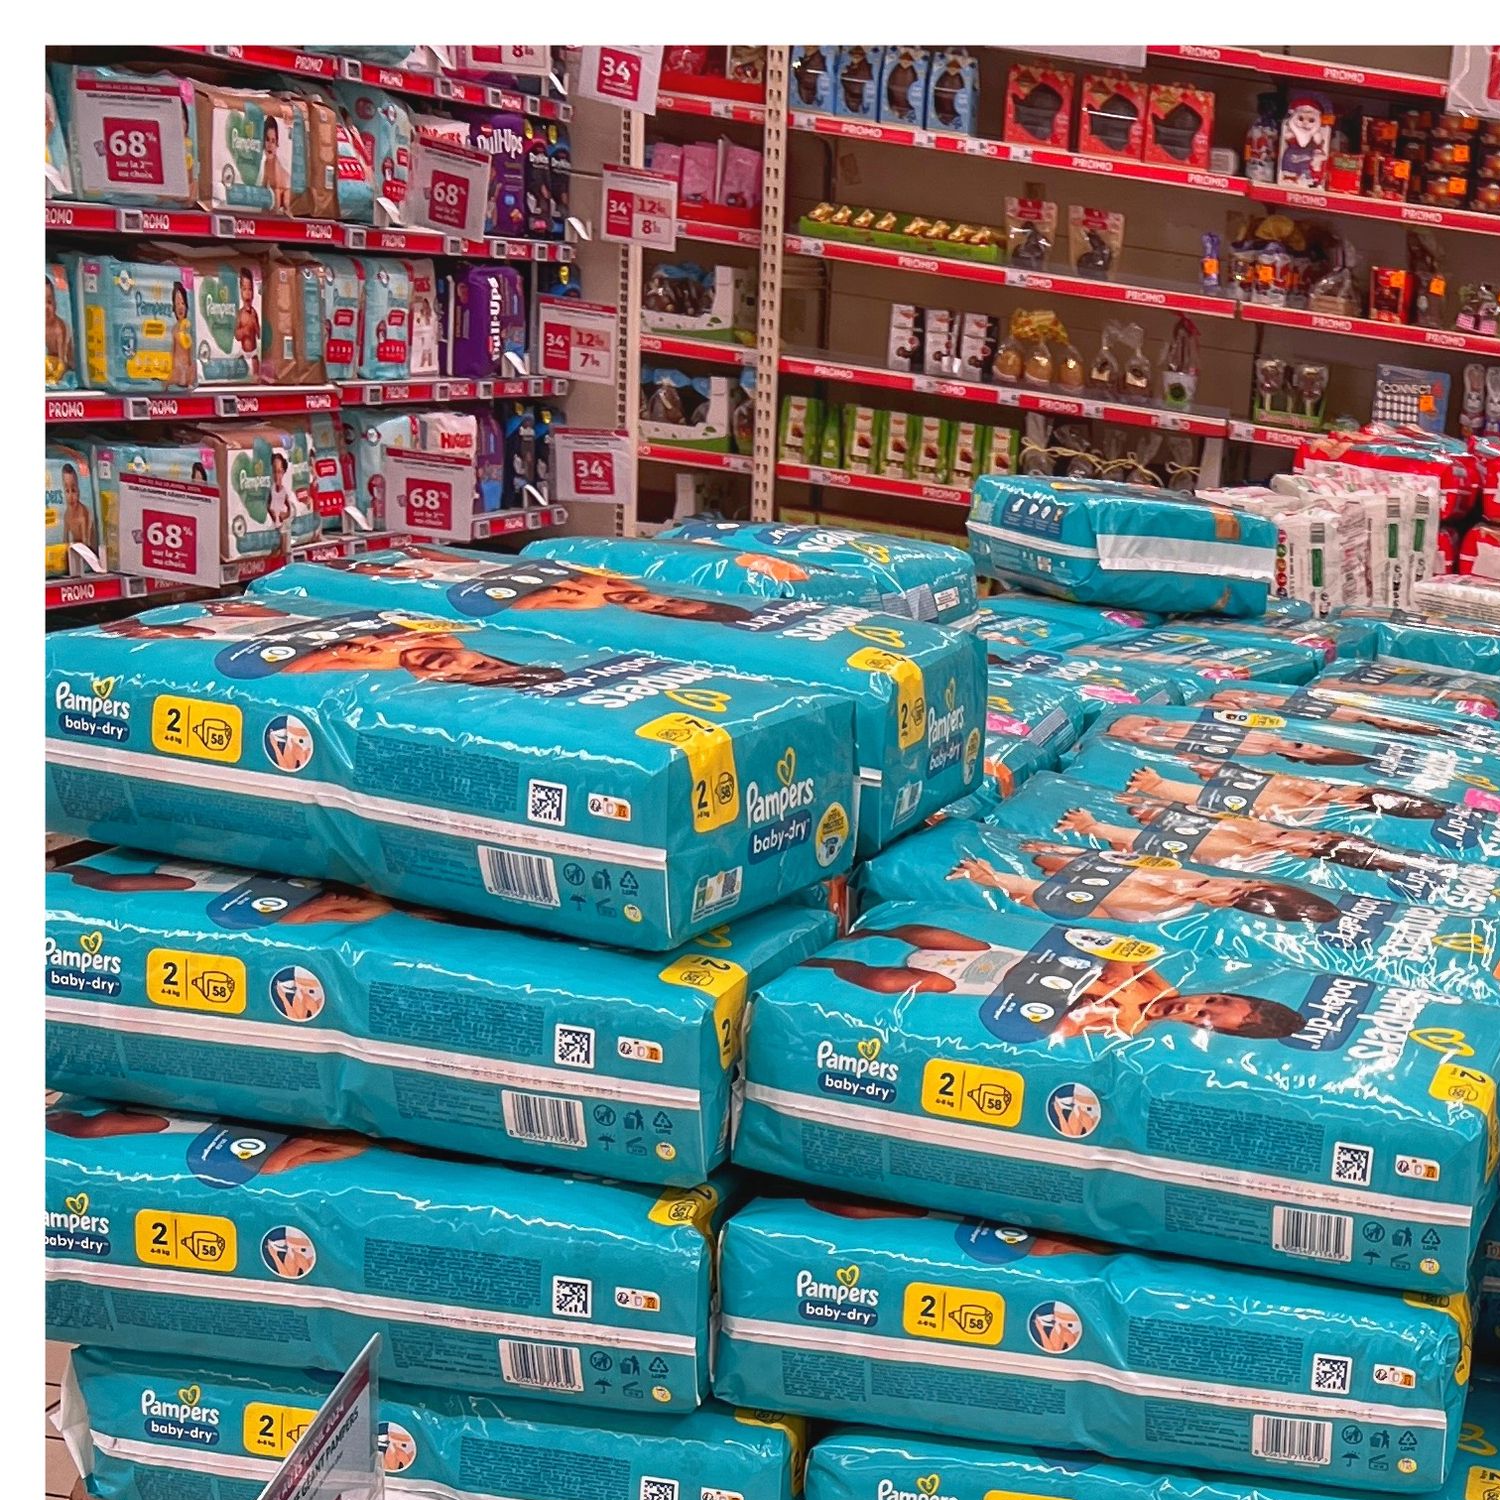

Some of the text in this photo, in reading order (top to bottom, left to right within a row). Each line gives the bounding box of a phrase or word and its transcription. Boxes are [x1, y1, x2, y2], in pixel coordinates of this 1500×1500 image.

[295, 57, 323, 73] PROMO
[1324, 68, 1365, 83] PROMO
[841, 123, 883, 138] PROMO
[898, 257, 939, 271] PROMO
[1312, 316, 1352, 331] PROMO
[49, 402, 84, 417] PROMO
[61, 583, 94, 601] PROMO
[56, 681, 130, 720] Pampers
[65, 716, 124, 740] baby-dry
[167, 708, 224, 746] 2 58
[695, 779, 707, 810] 2
[746, 778, 814, 829] Pampers
[753, 820, 807, 854] baby-dry
[45, 937, 121, 974] Pampers
[51, 972, 116, 996] baby-dry
[163, 962, 227, 998] 2 58
[817, 1048, 900, 1081] Pampers
[824, 1073, 890, 1099] baby-dry
[940, 1072, 1003, 1111] 2 58
[796, 1269, 879, 1306] Pampers
[806, 1303, 872, 1325] baby-dry
[920, 1295, 984, 1330] 2 58
[141, 1389, 220, 1426] Pampers
[151, 1422, 212, 1441] baby-dry
[259, 1415, 274, 1438] 2
[325, 1406, 359, 1456] PAMPERS
